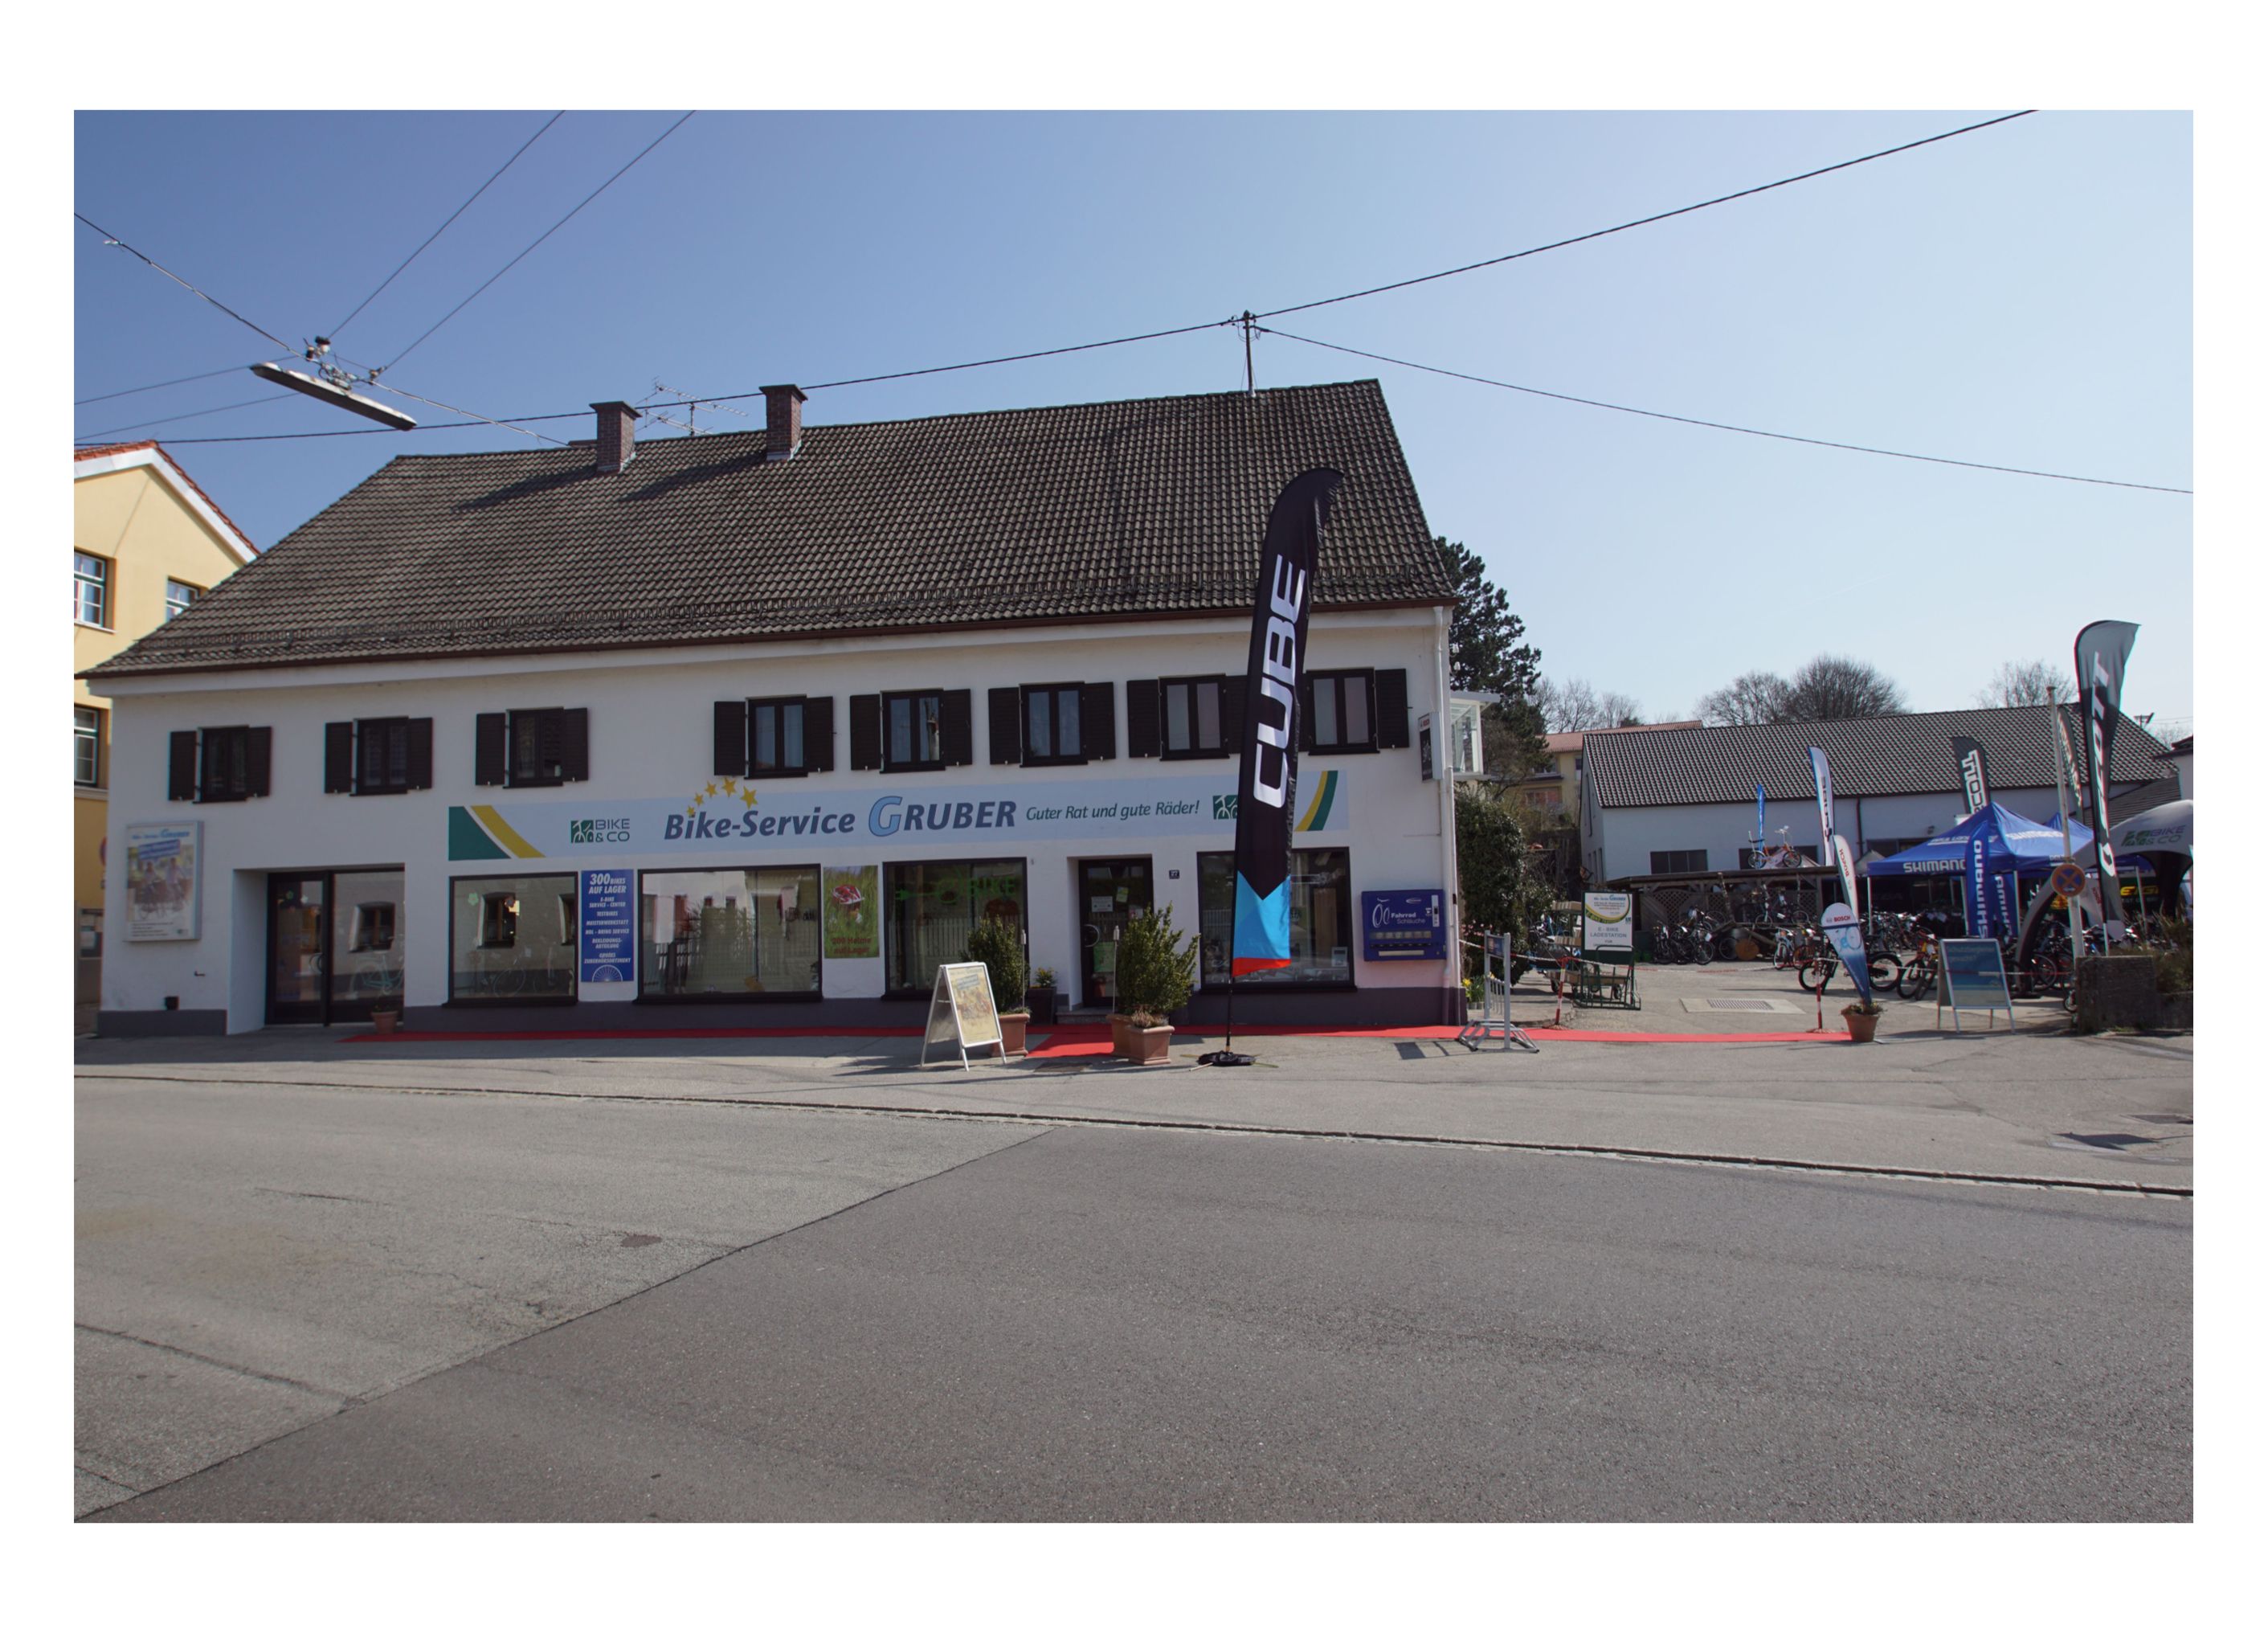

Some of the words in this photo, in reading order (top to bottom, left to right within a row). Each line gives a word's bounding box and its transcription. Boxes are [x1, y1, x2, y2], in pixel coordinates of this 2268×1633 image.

[1253, 554, 1306, 808] CUBE
[595, 818, 630, 830] BIKE
[664, 806, 856, 840] Bike-Service
[868, 796, 1017, 837] GRUBER
[1026, 806, 1062, 821] Guter
[1065, 805, 1089, 819] Rat
[1092, 804, 1118, 818] und
[1120, 804, 1150, 821] gute
[1155, 800, 1200, 815] Räder!
[595, 833, 604, 842] &
[607, 831, 630, 842] CO
[2150, 825, 2186, 837] BIKE
[2157, 834, 2181, 844] CO
[590, 873, 611, 886] 300
[588, 886, 603, 894] AUF
[604, 886, 627, 894] LAGER
[1973, 840, 1988, 939] SHIMANO
